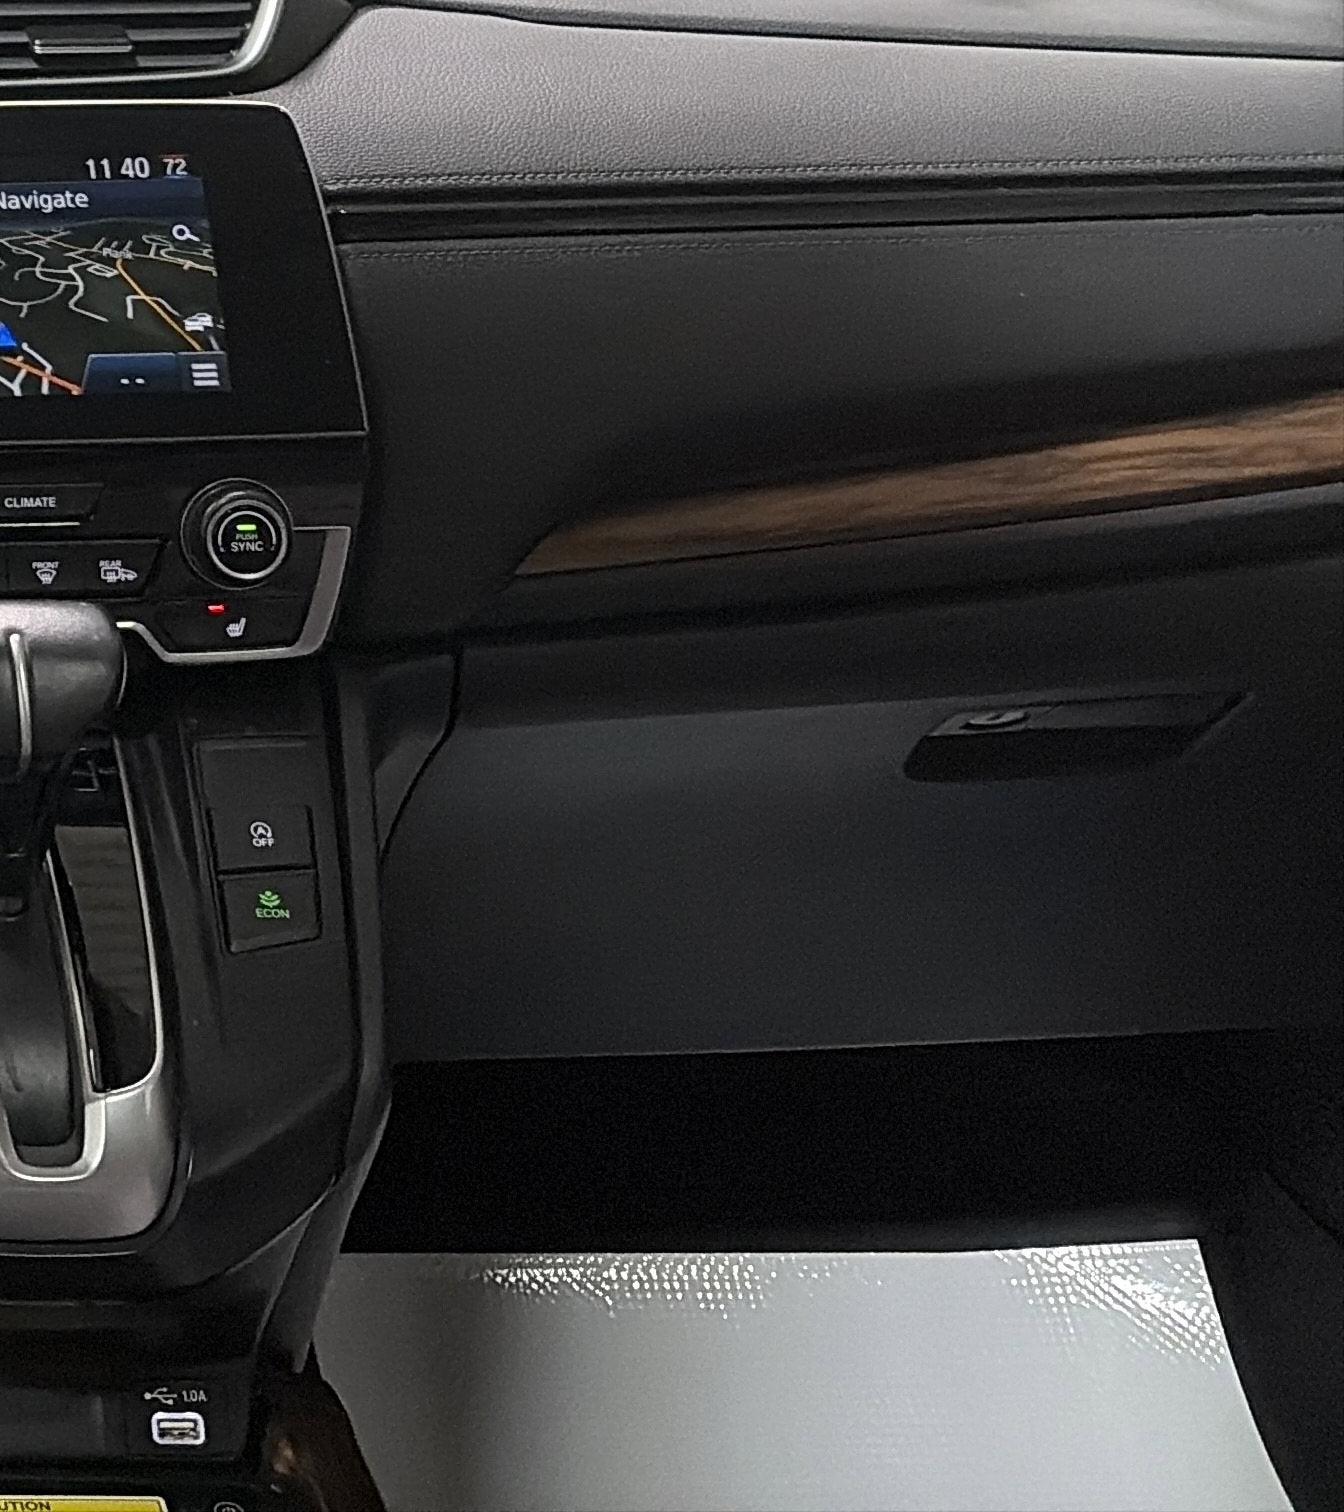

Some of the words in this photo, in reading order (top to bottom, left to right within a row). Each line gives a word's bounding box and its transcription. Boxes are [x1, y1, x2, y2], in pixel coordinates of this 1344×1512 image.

[162, 158, 189, 176] 72
[4, 496, 56, 508] CLIMATE
[235, 533, 258, 541] PUSH
[230, 540, 264, 553] SYNC
[32, 561, 60, 570] FRONT
[99, 560, 122, 569] REAR
[252, 838, 275, 848] OFF
[255, 907, 290, 919] ECON
